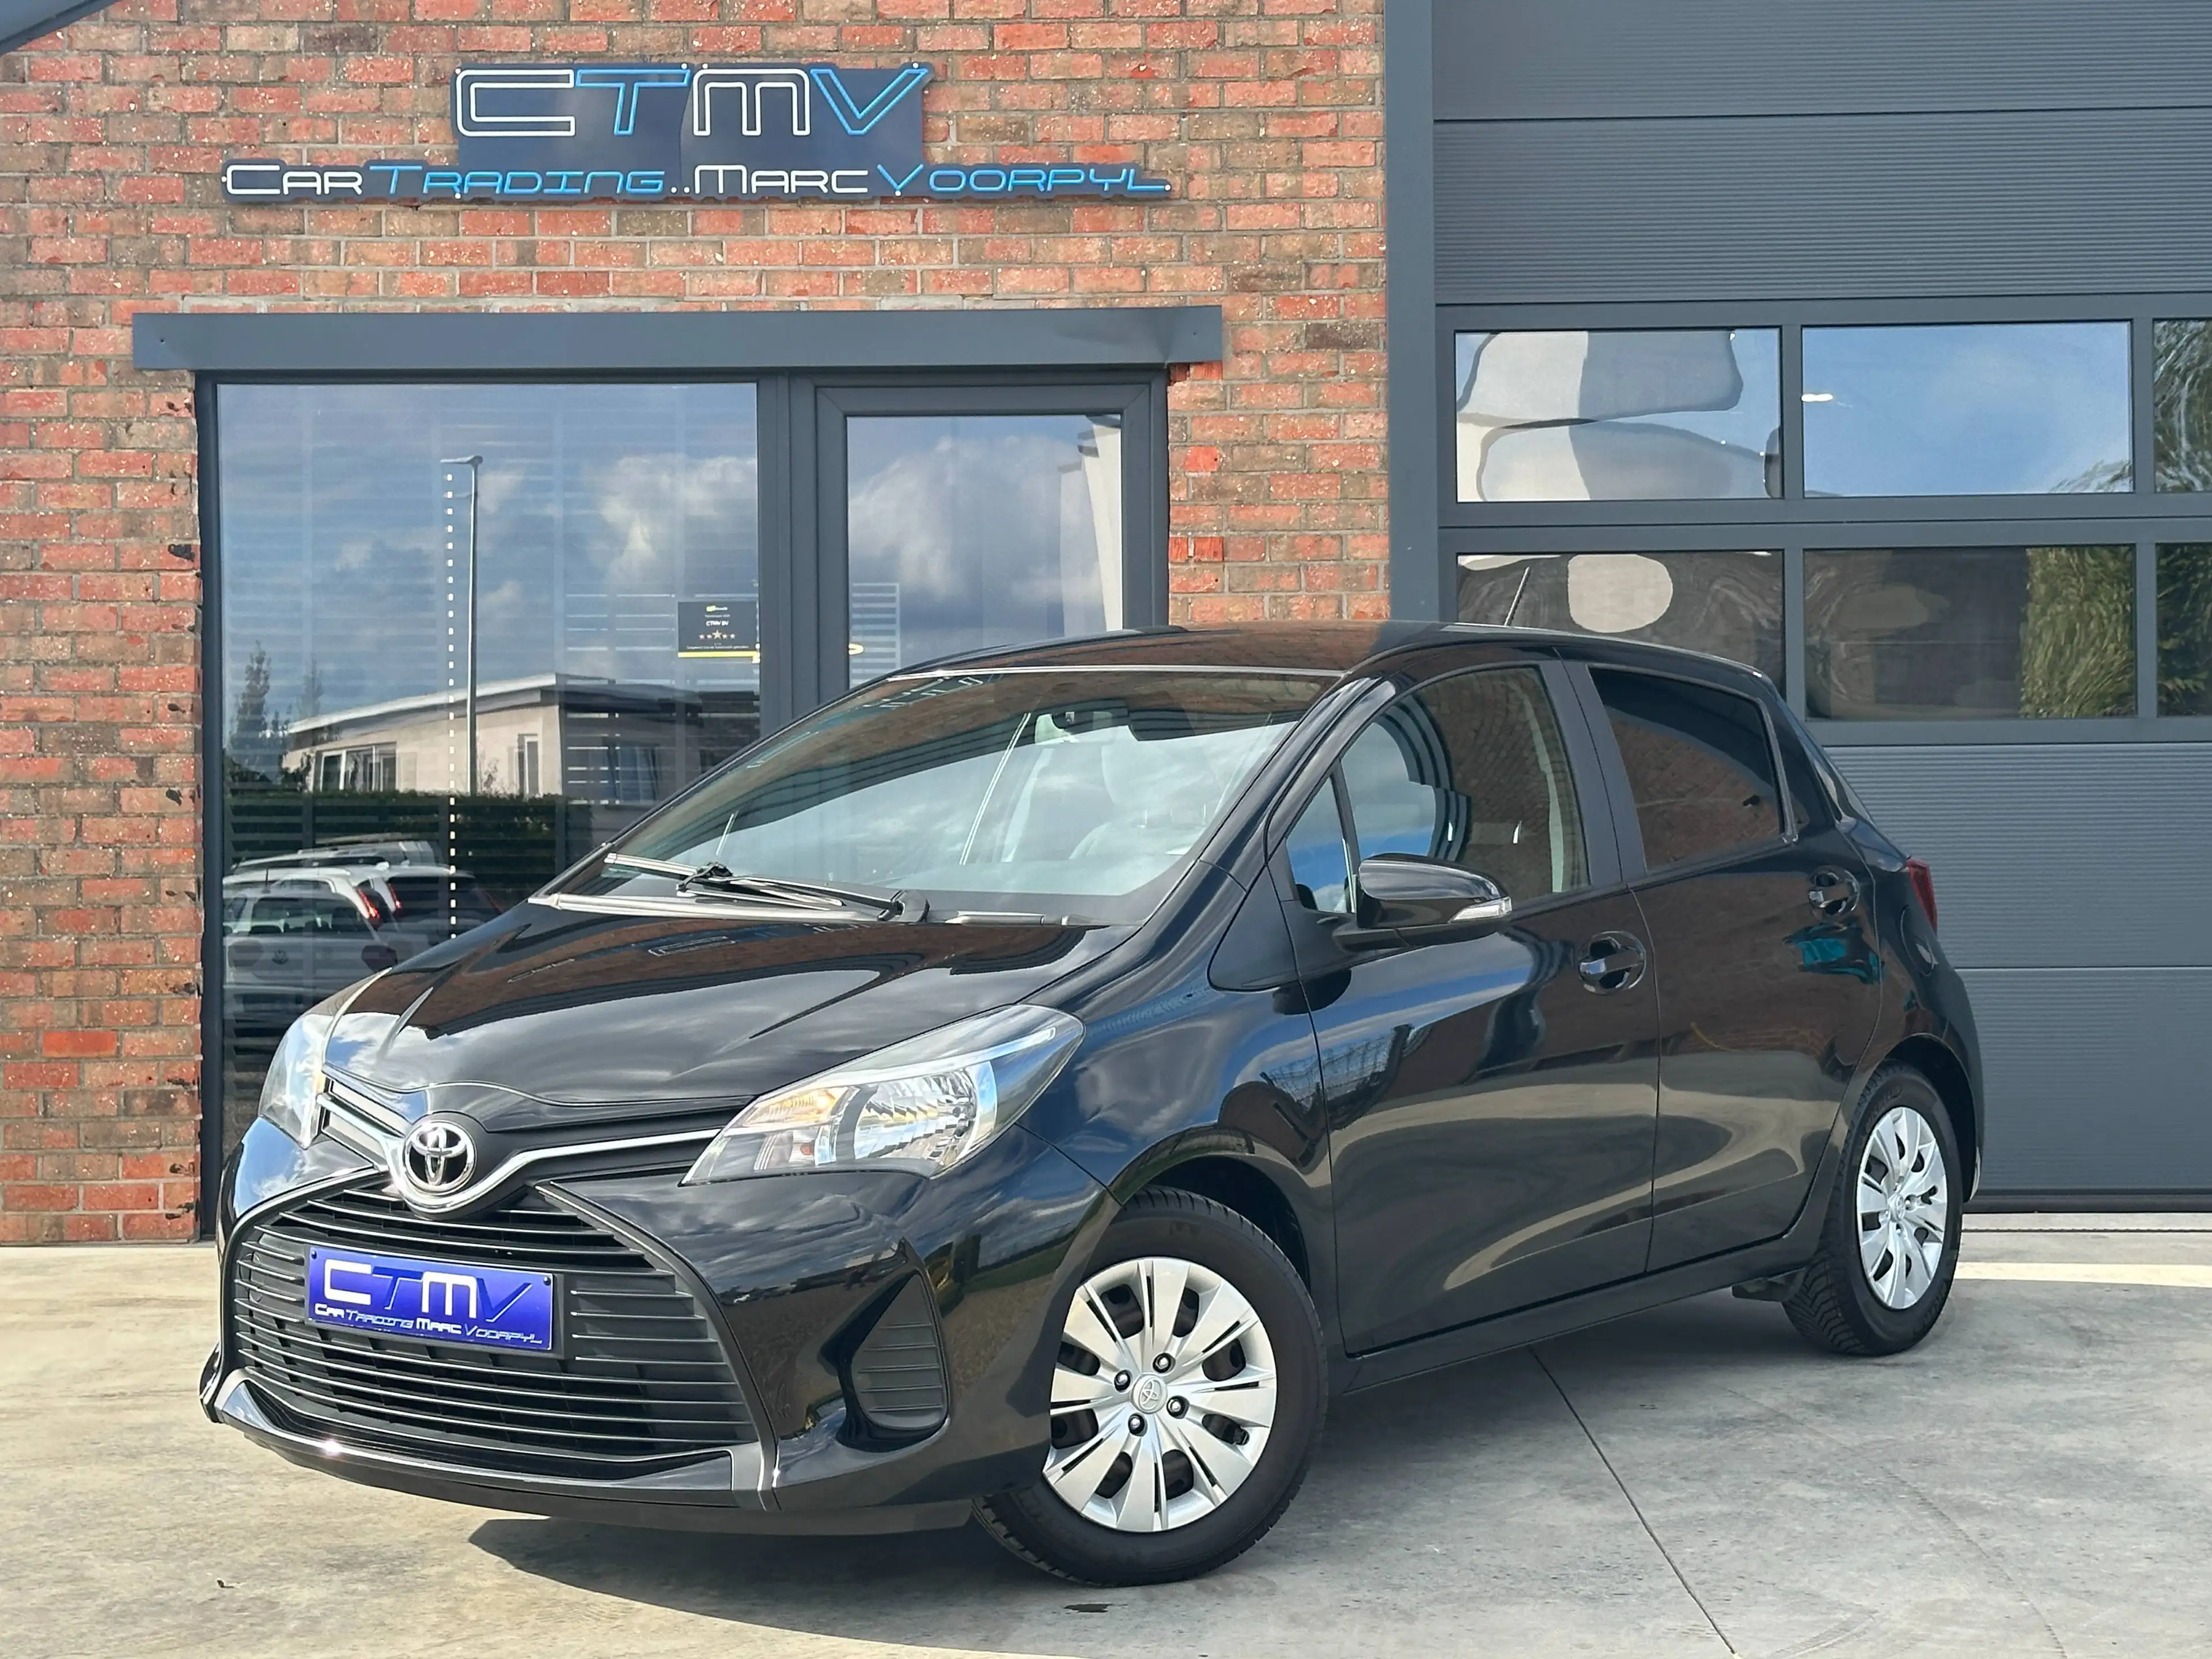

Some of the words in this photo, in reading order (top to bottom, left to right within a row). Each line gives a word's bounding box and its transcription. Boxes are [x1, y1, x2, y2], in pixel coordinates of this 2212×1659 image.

[456, 68, 929, 137] CTMV
[226, 164, 363, 196] CAR
[369, 165, 665, 195] TRADING
[695, 164, 869, 194] MARC
[877, 164, 1171, 193] VOORPYL
[324, 1258, 533, 1323] CTMV
[314, 1302, 345, 1317] CAR
[346, 1309, 414, 1328] TRADING
[416, 1317, 463, 1335] MARC
[464, 1324, 543, 1344] VOORPYL
